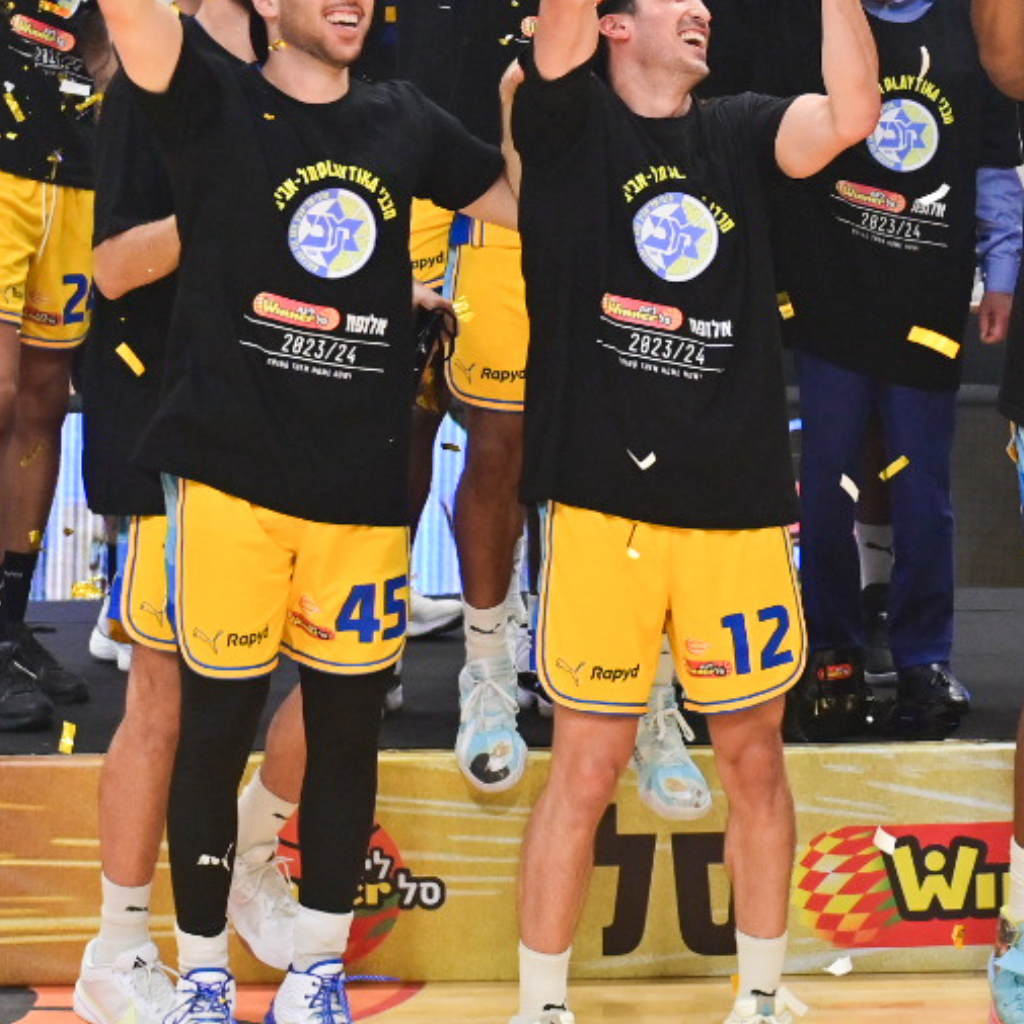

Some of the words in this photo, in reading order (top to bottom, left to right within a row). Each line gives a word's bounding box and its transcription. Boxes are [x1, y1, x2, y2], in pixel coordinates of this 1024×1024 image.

[411, 251, 444, 271] apyd
[345, 313, 388, 336] אלופת
[281, 333, 357, 365] 2023/24
[628, 333, 706, 365] 2023/24
[336, 574, 407, 644] 45
[227, 624, 270, 648] Rapyd
[721, 604, 794, 676] 12
[590, 663, 640, 684] Rapyd
[398, 872, 442, 906] סל
